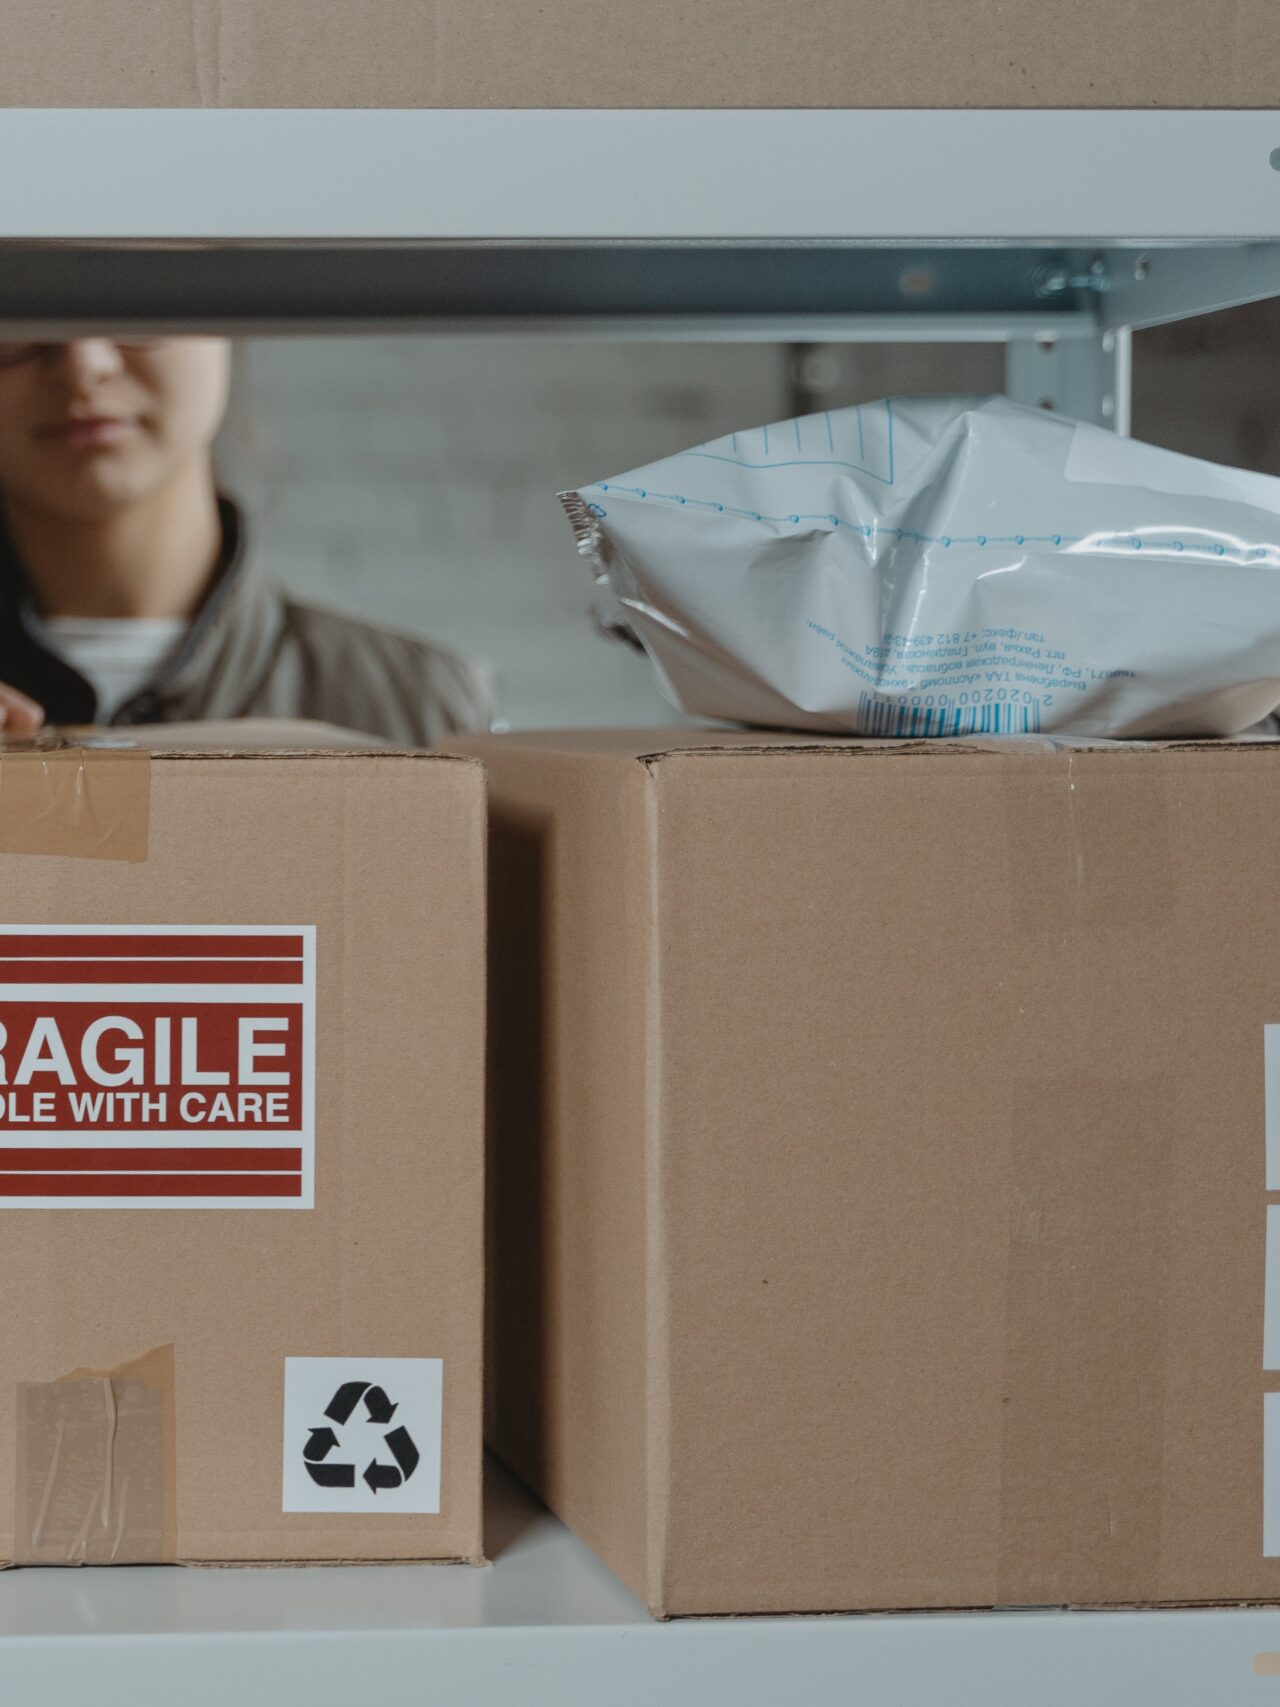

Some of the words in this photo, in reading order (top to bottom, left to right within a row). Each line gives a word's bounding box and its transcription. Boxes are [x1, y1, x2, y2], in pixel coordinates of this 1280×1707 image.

[937, 633, 960, 645] 812
[963, 632, 977, 641] +7
[986, 671, 1011, 682] ТАА
[1058, 664, 1082, 678] РФ,
[1015, 672, 1087, 690] Выраблена
[959, 688, 1032, 706] 020200
[1043, 694, 1053, 707] 2
[68, 1092, 167, 1123] WITH
[179, 1091, 290, 1124] CARE
